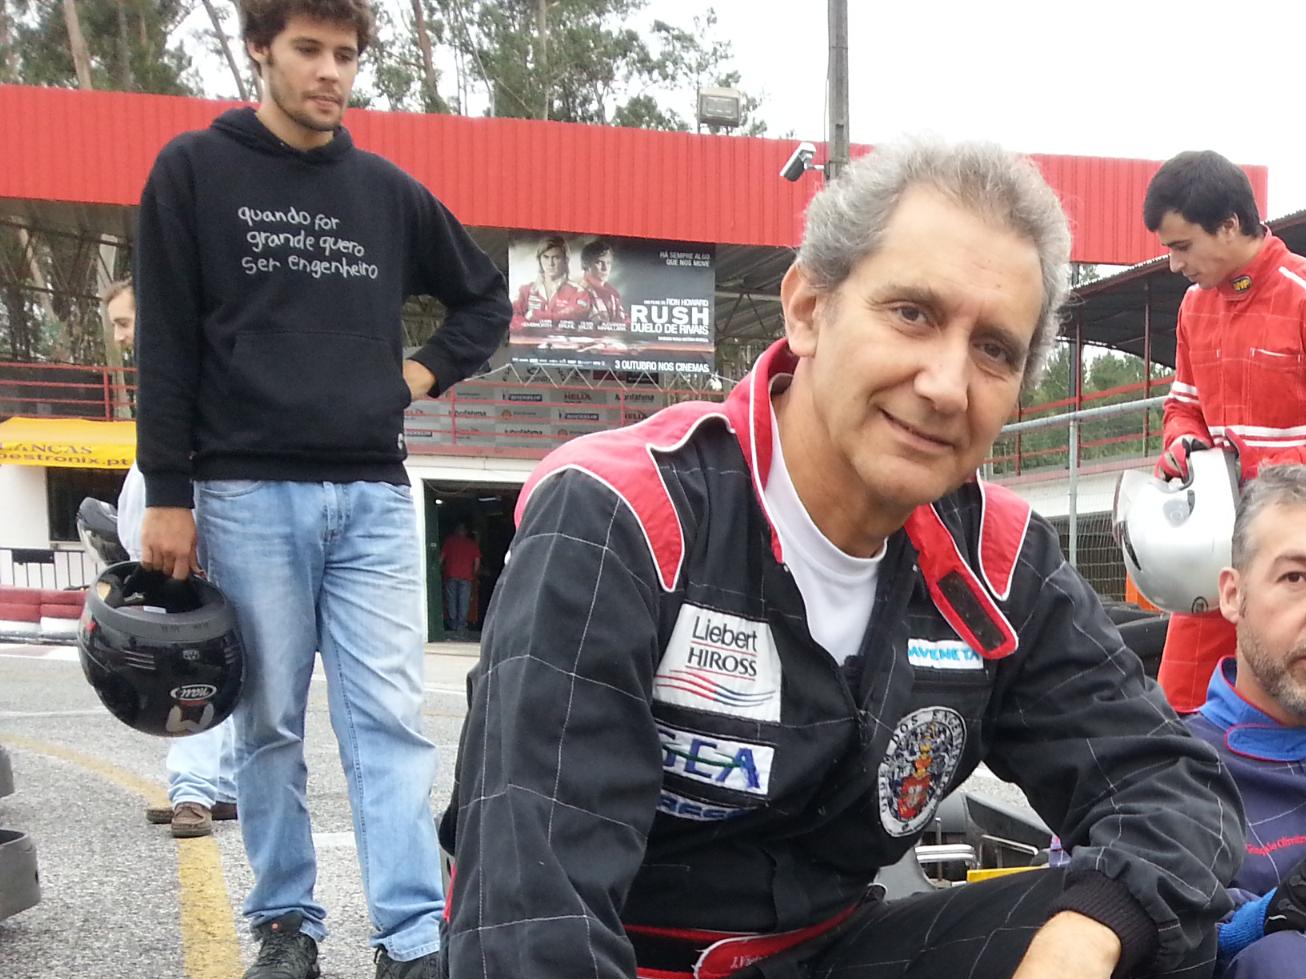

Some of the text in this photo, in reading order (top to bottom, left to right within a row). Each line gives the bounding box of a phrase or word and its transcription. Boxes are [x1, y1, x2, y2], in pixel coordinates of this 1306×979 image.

[238, 206, 340, 230] quando for
[246, 230, 365, 256] grande quero
[288, 255, 378, 279] engenheiro
[630, 304, 710, 326] RUSH
[631, 322, 663, 333] DUELO
[664, 323, 678, 334] DE
[679, 324, 710, 335] RIVAIS
[614, 360, 620, 369] 3
[621, 360, 657, 371] OUTUBRO
[658, 361, 675, 371] NOS
[675, 362, 710, 373] CINEMAS
[692, 616, 758, 653] Liebert
[687, 646, 758, 677] HIROSS
